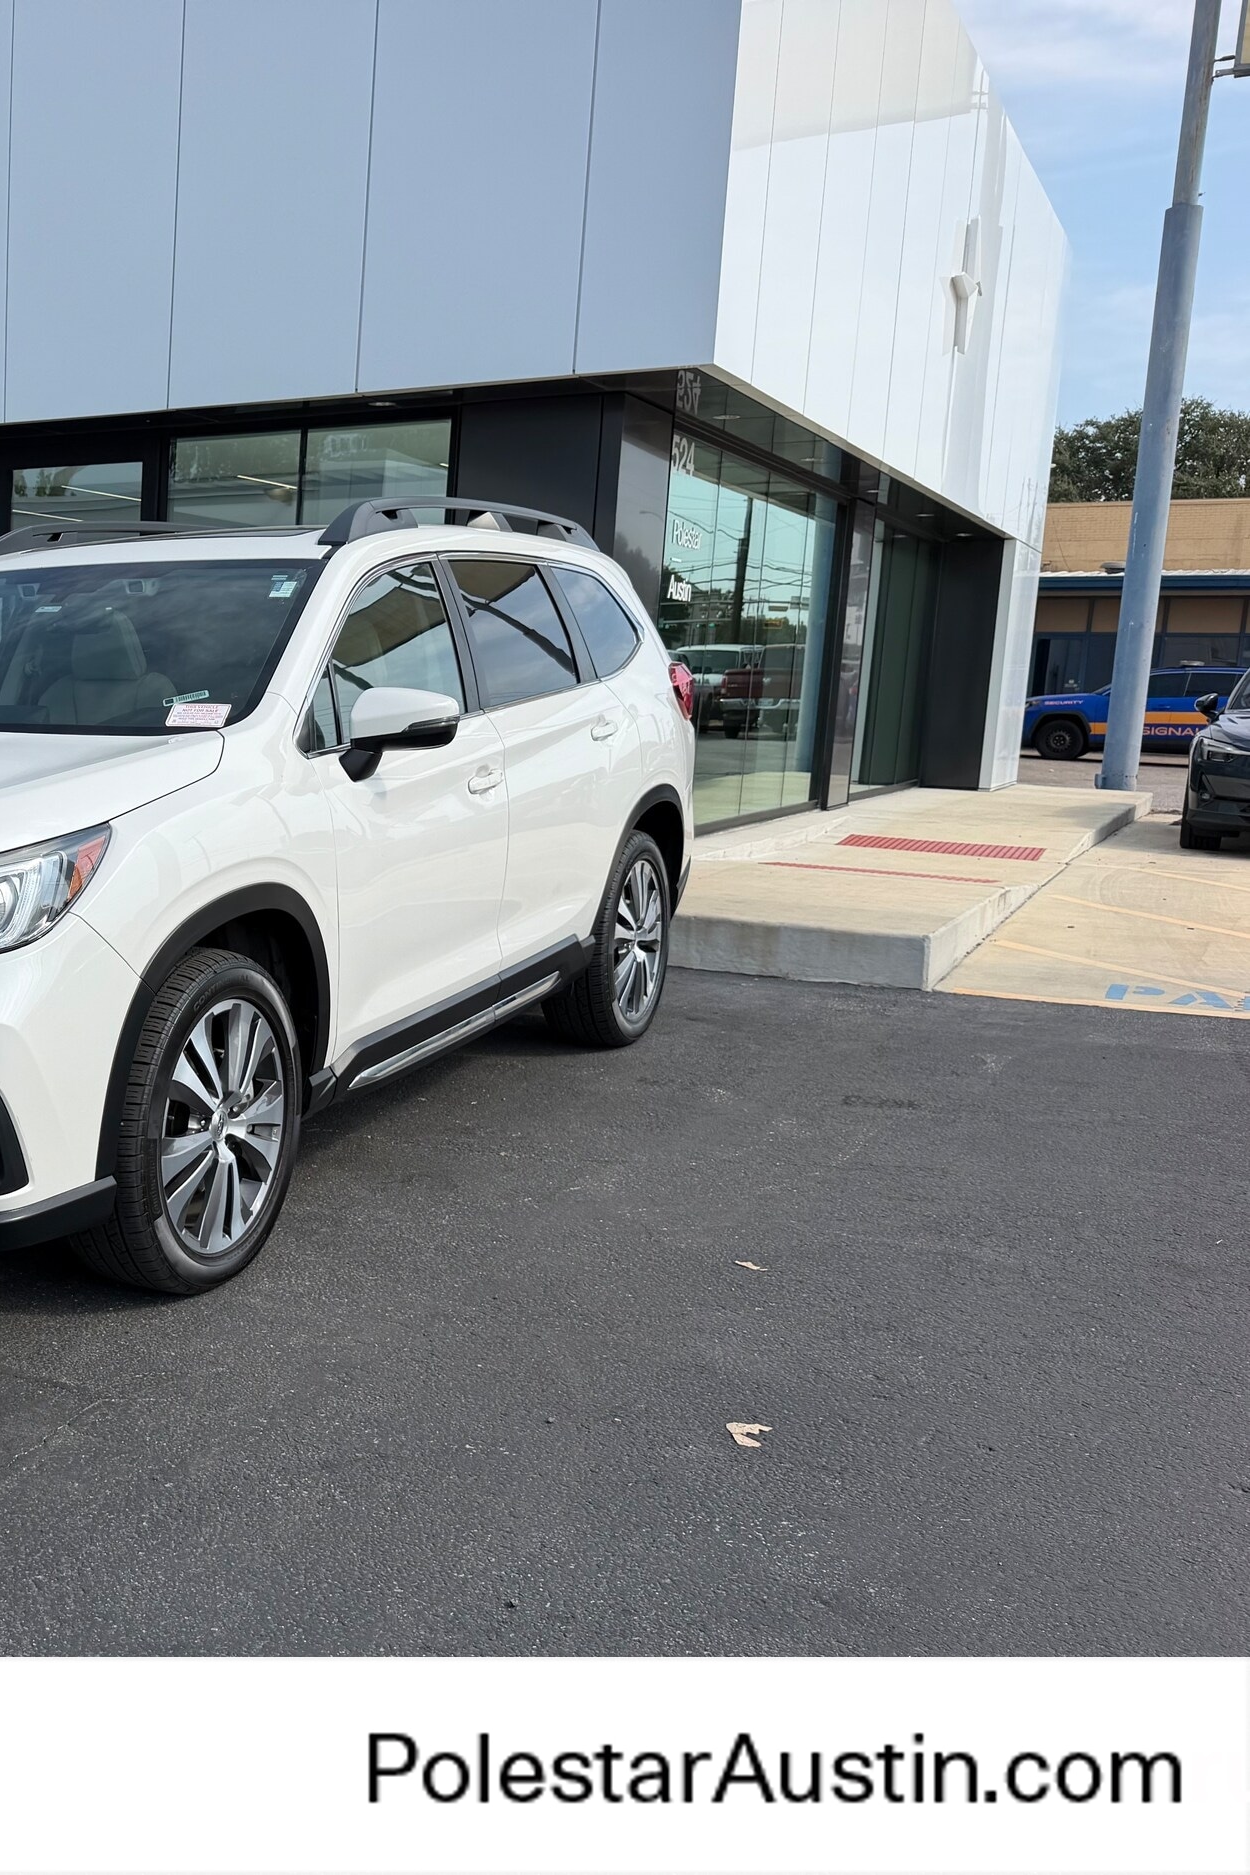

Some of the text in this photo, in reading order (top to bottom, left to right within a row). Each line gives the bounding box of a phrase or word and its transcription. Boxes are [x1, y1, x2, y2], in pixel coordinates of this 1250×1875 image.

[671, 434, 695, 476] 524
[672, 519, 703, 551] Polestar
[666, 574, 692, 602] Austin
[1105, 983, 1250, 1011] PA
